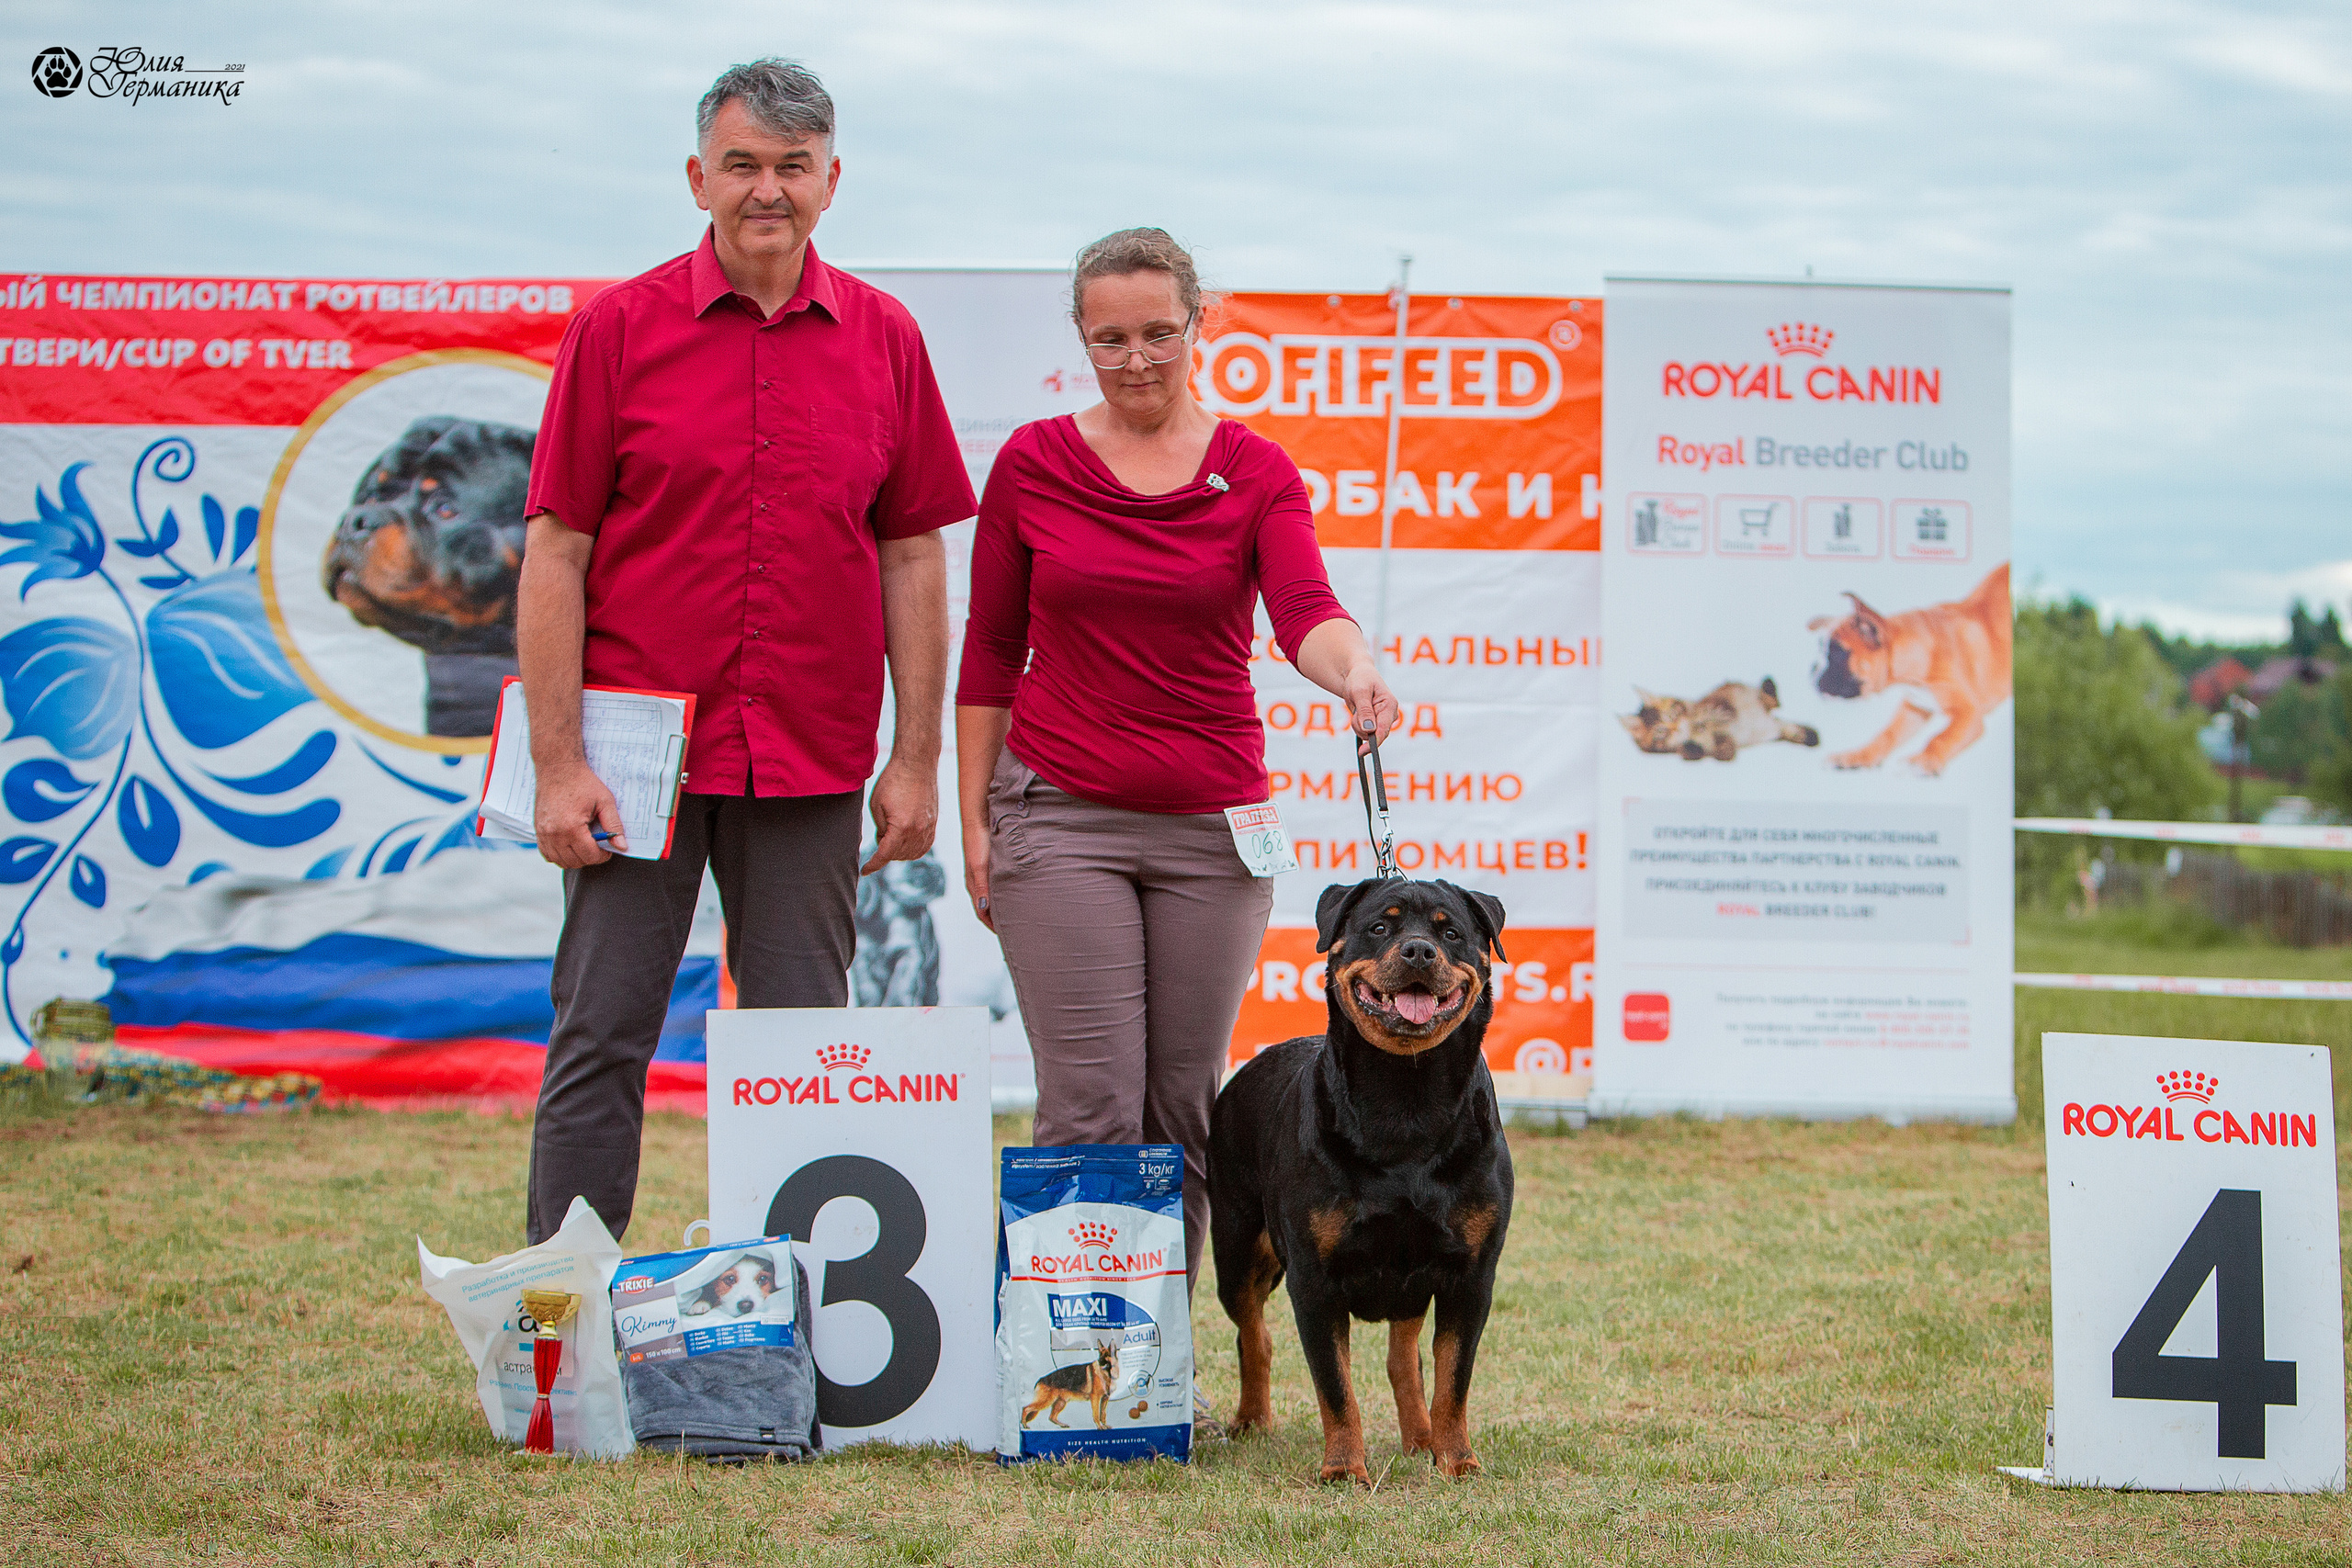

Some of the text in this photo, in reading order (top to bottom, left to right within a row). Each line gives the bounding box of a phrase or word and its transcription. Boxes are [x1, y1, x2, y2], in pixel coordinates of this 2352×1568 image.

[55, 281, 299, 311] ЧЕМПИОНАТ
[305, 277, 575, 314] РОТВЕЙЛЕРОВ
[202, 339, 254, 367] OF
[258, 339, 355, 369] TVER
[1662, 360, 1941, 404] ROYAL CANIN
[1657, 434, 1971, 473] Royal Breeder Club
[1507, 471, 1553, 520] И
[1251, 829, 1283, 859] 068
[1294, 829, 1589, 876] ПИОМЦЕВ!
[732, 1073, 958, 1106] ROYAL CANIN
[2063, 1102, 2318, 1148] ROYAL CANIN
[1138, 1162, 1146, 1175] 3
[461, 1255, 574, 1293] Разработка и производство
[1030, 1248, 1163, 1274] ROYAL CANIN
[468, 1264, 574, 1303] ветеринарных препаратов
[618, 1276, 655, 1293] TRIXIE
[763, 1154, 943, 1428] 3
[1052, 1297, 1108, 1318] MAXI
[2111, 1188, 2298, 1461] 4
[621, 1315, 678, 1337] Kimmy
[1123, 1328, 1157, 1345] Adult
[645, 1350, 657, 1359] 150
